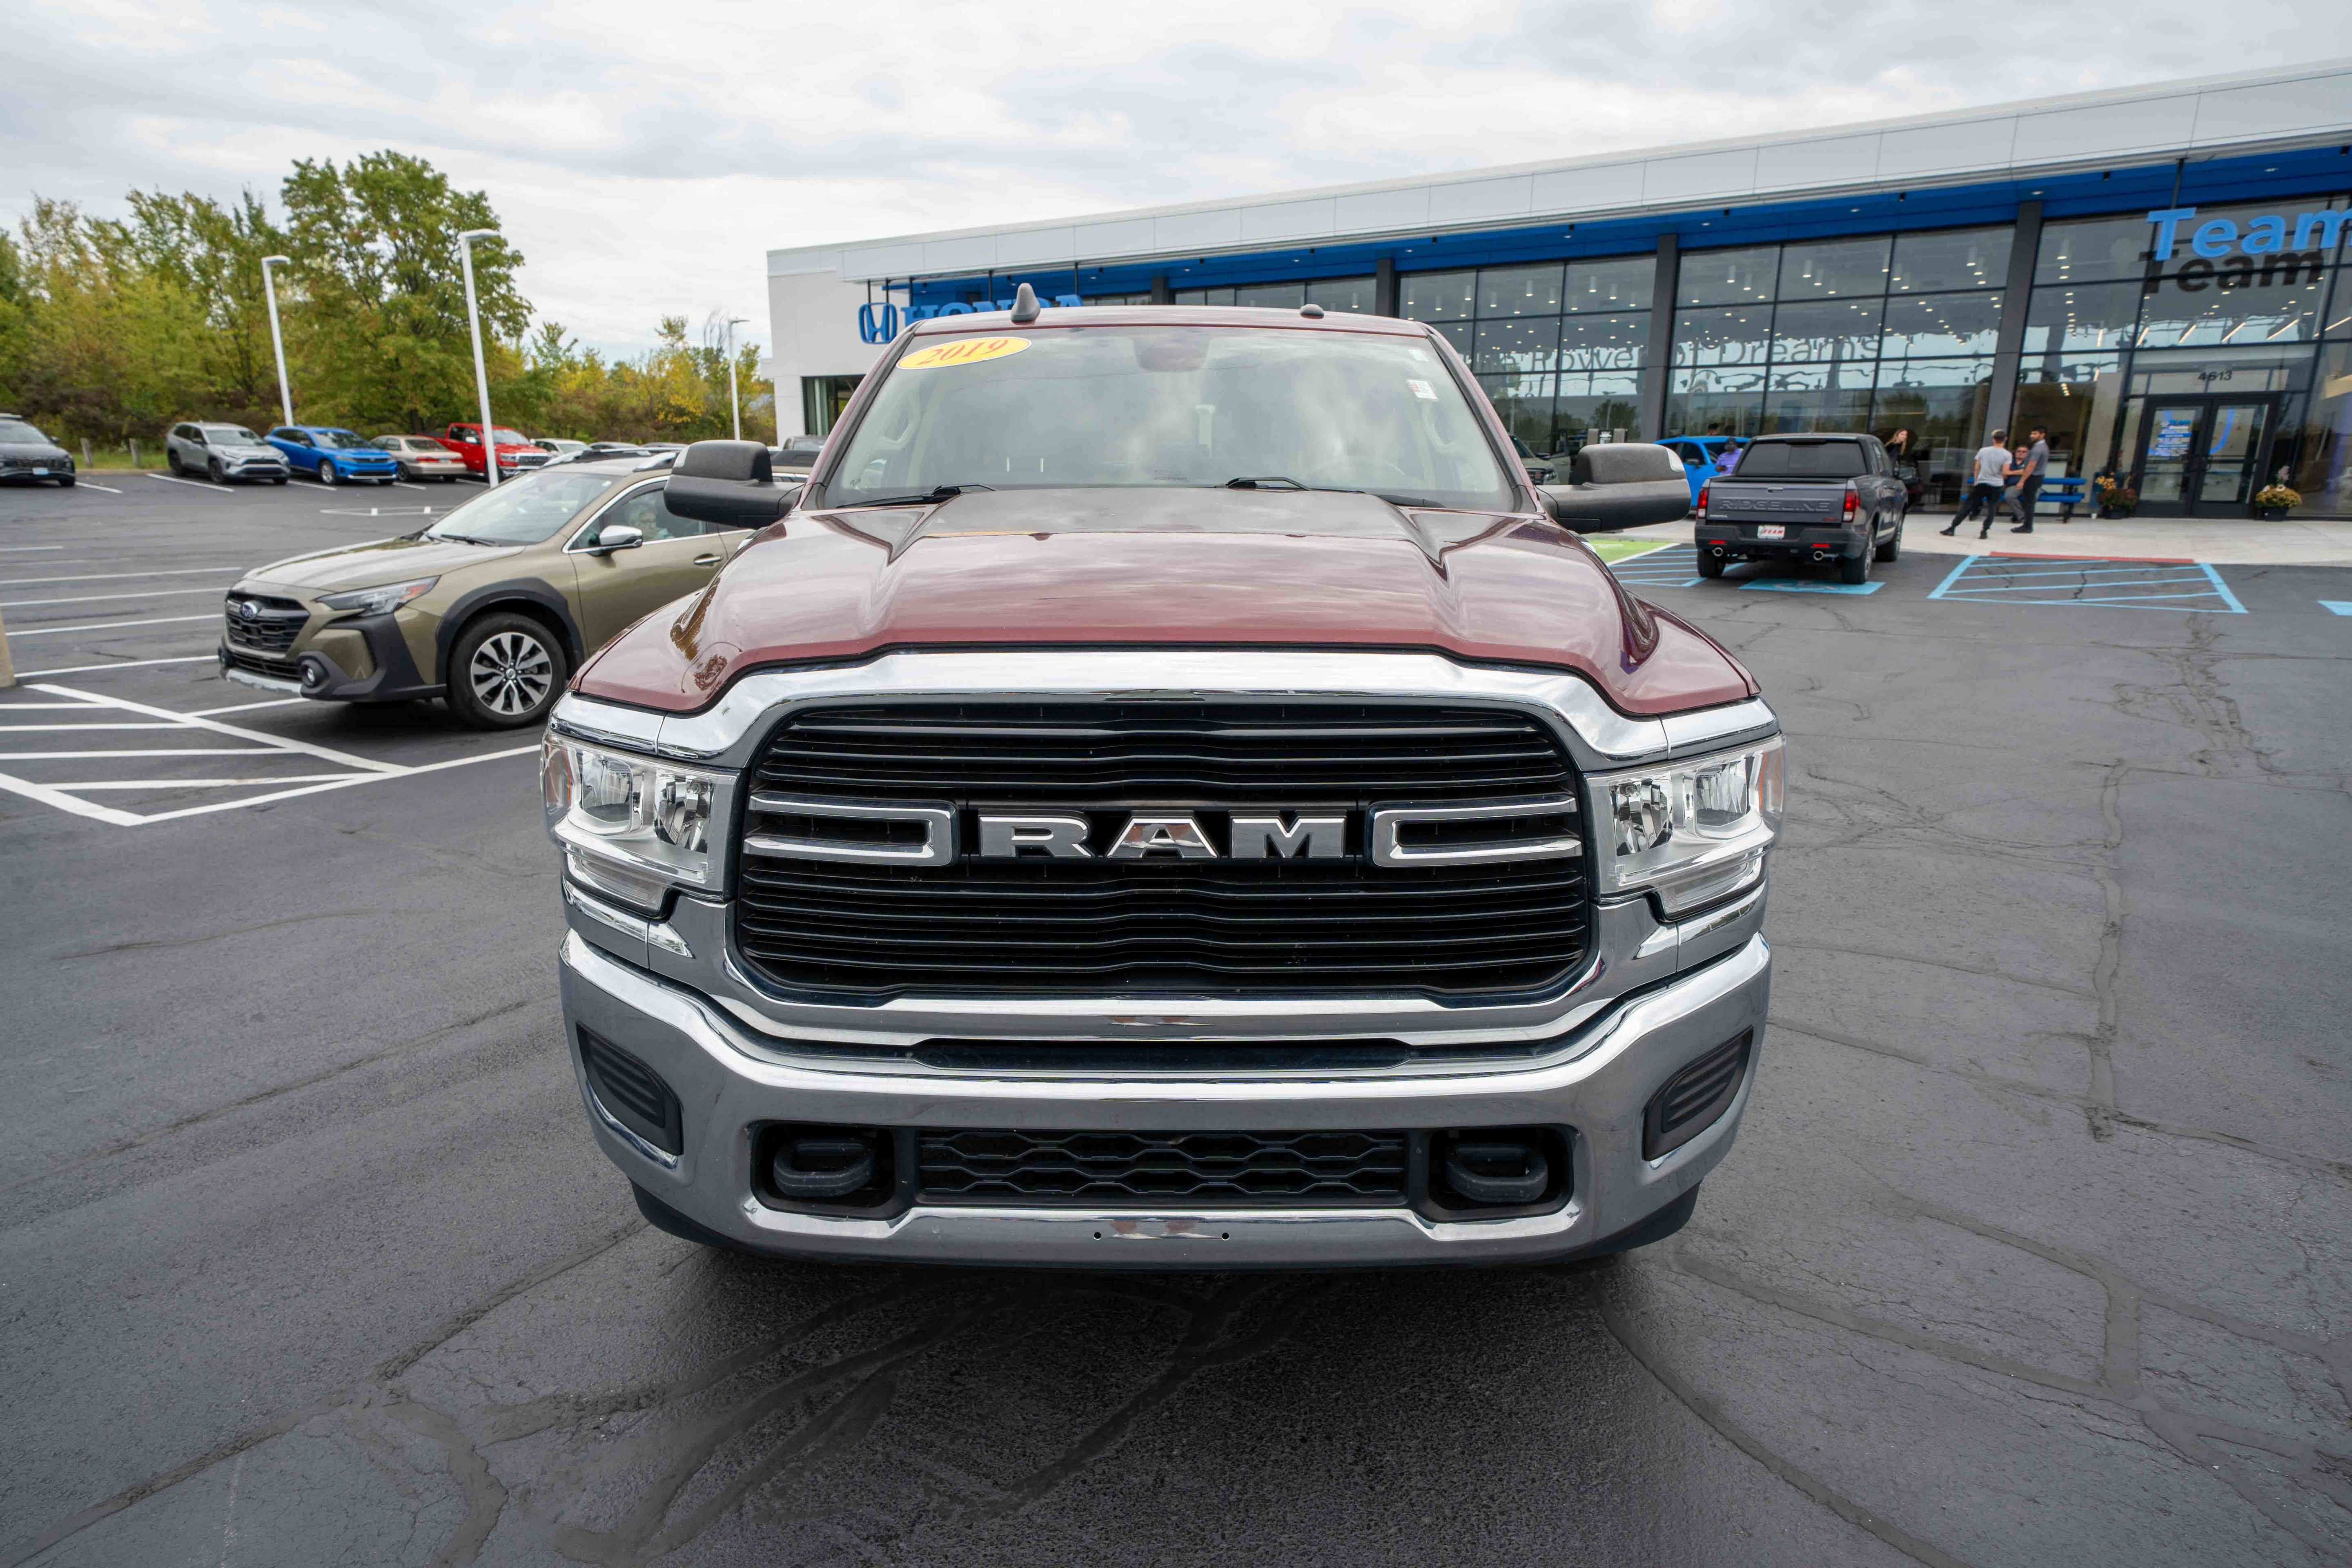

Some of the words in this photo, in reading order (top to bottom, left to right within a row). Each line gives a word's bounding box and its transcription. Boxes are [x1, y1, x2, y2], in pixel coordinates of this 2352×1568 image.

[2147, 207, 2352, 261] Team
[916, 339, 1009, 365] 2019
[2198, 371, 2232, 381] 4613
[1719, 499, 1830, 511] RIDGELINE
[979, 814, 1346, 859] RAM
